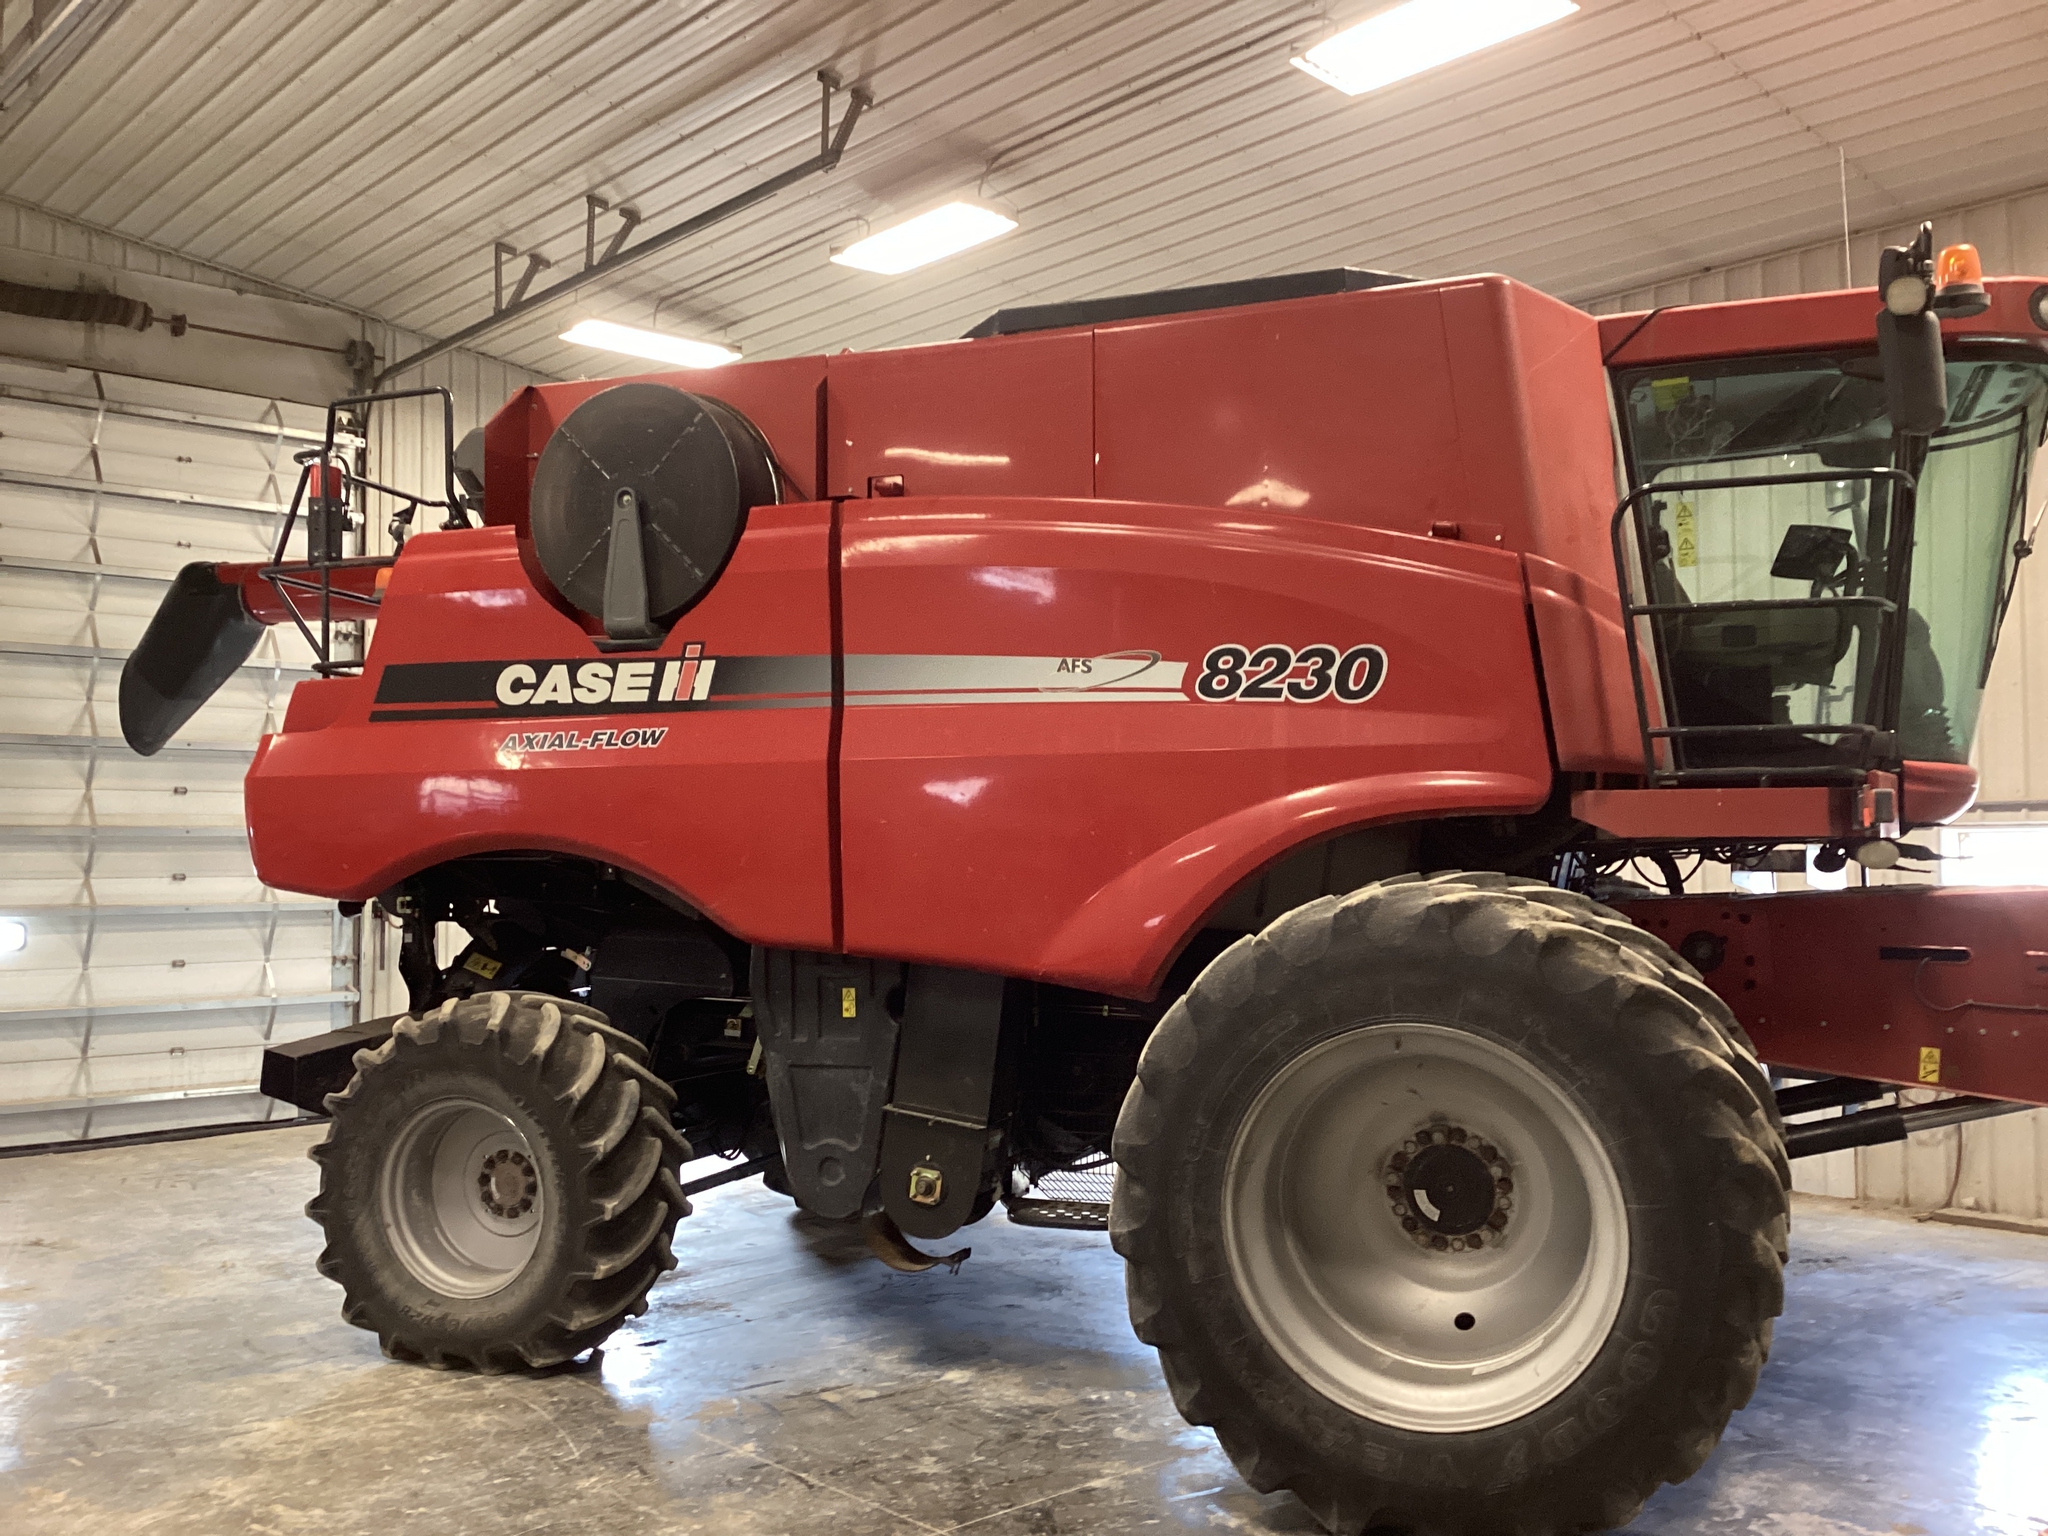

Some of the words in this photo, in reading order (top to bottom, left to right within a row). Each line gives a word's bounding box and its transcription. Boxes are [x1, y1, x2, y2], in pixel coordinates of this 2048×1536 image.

[495, 661, 654, 705] CASE
[1056, 658, 1093, 674] AFS
[1195, 643, 1388, 704] 8230
[500, 727, 668, 752] AXIAL-FLOW
